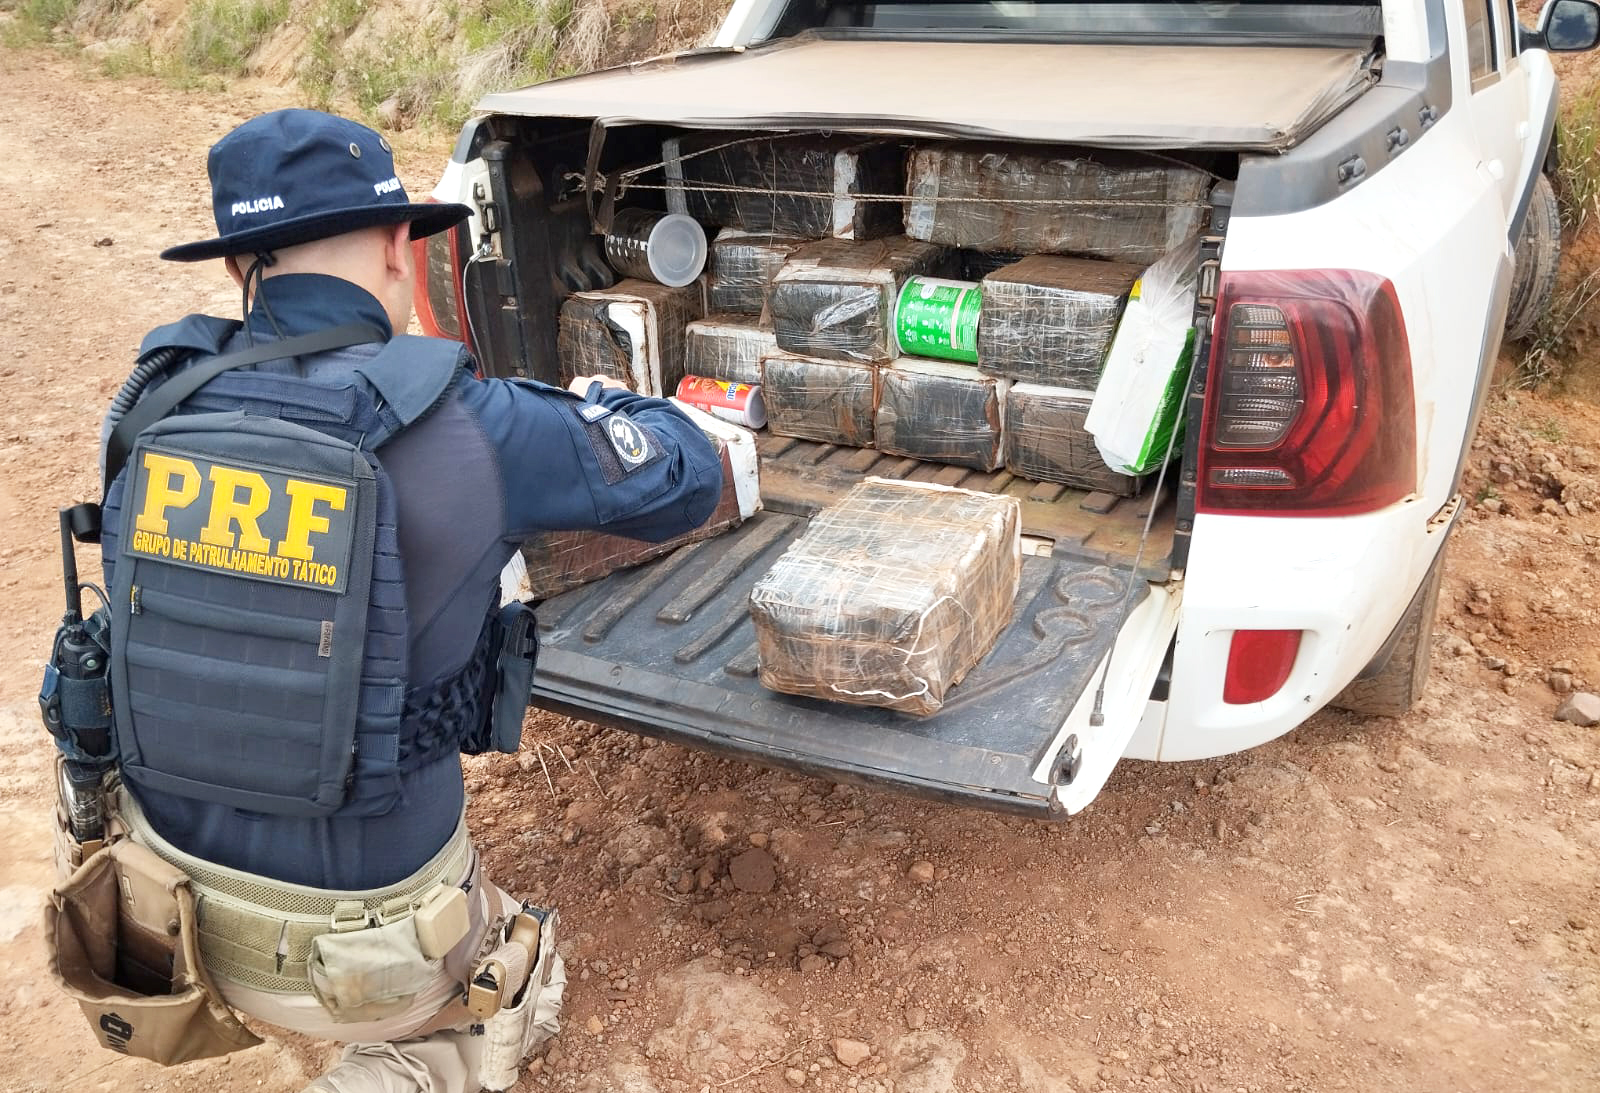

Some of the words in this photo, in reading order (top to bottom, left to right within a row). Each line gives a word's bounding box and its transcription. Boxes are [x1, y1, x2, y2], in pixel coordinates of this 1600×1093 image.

[136, 453, 347, 560] PRF
[133, 530, 171, 557] GRUPO
[173, 538, 188, 560] DE
[189, 542, 290, 578] PATRULHAMENTO
